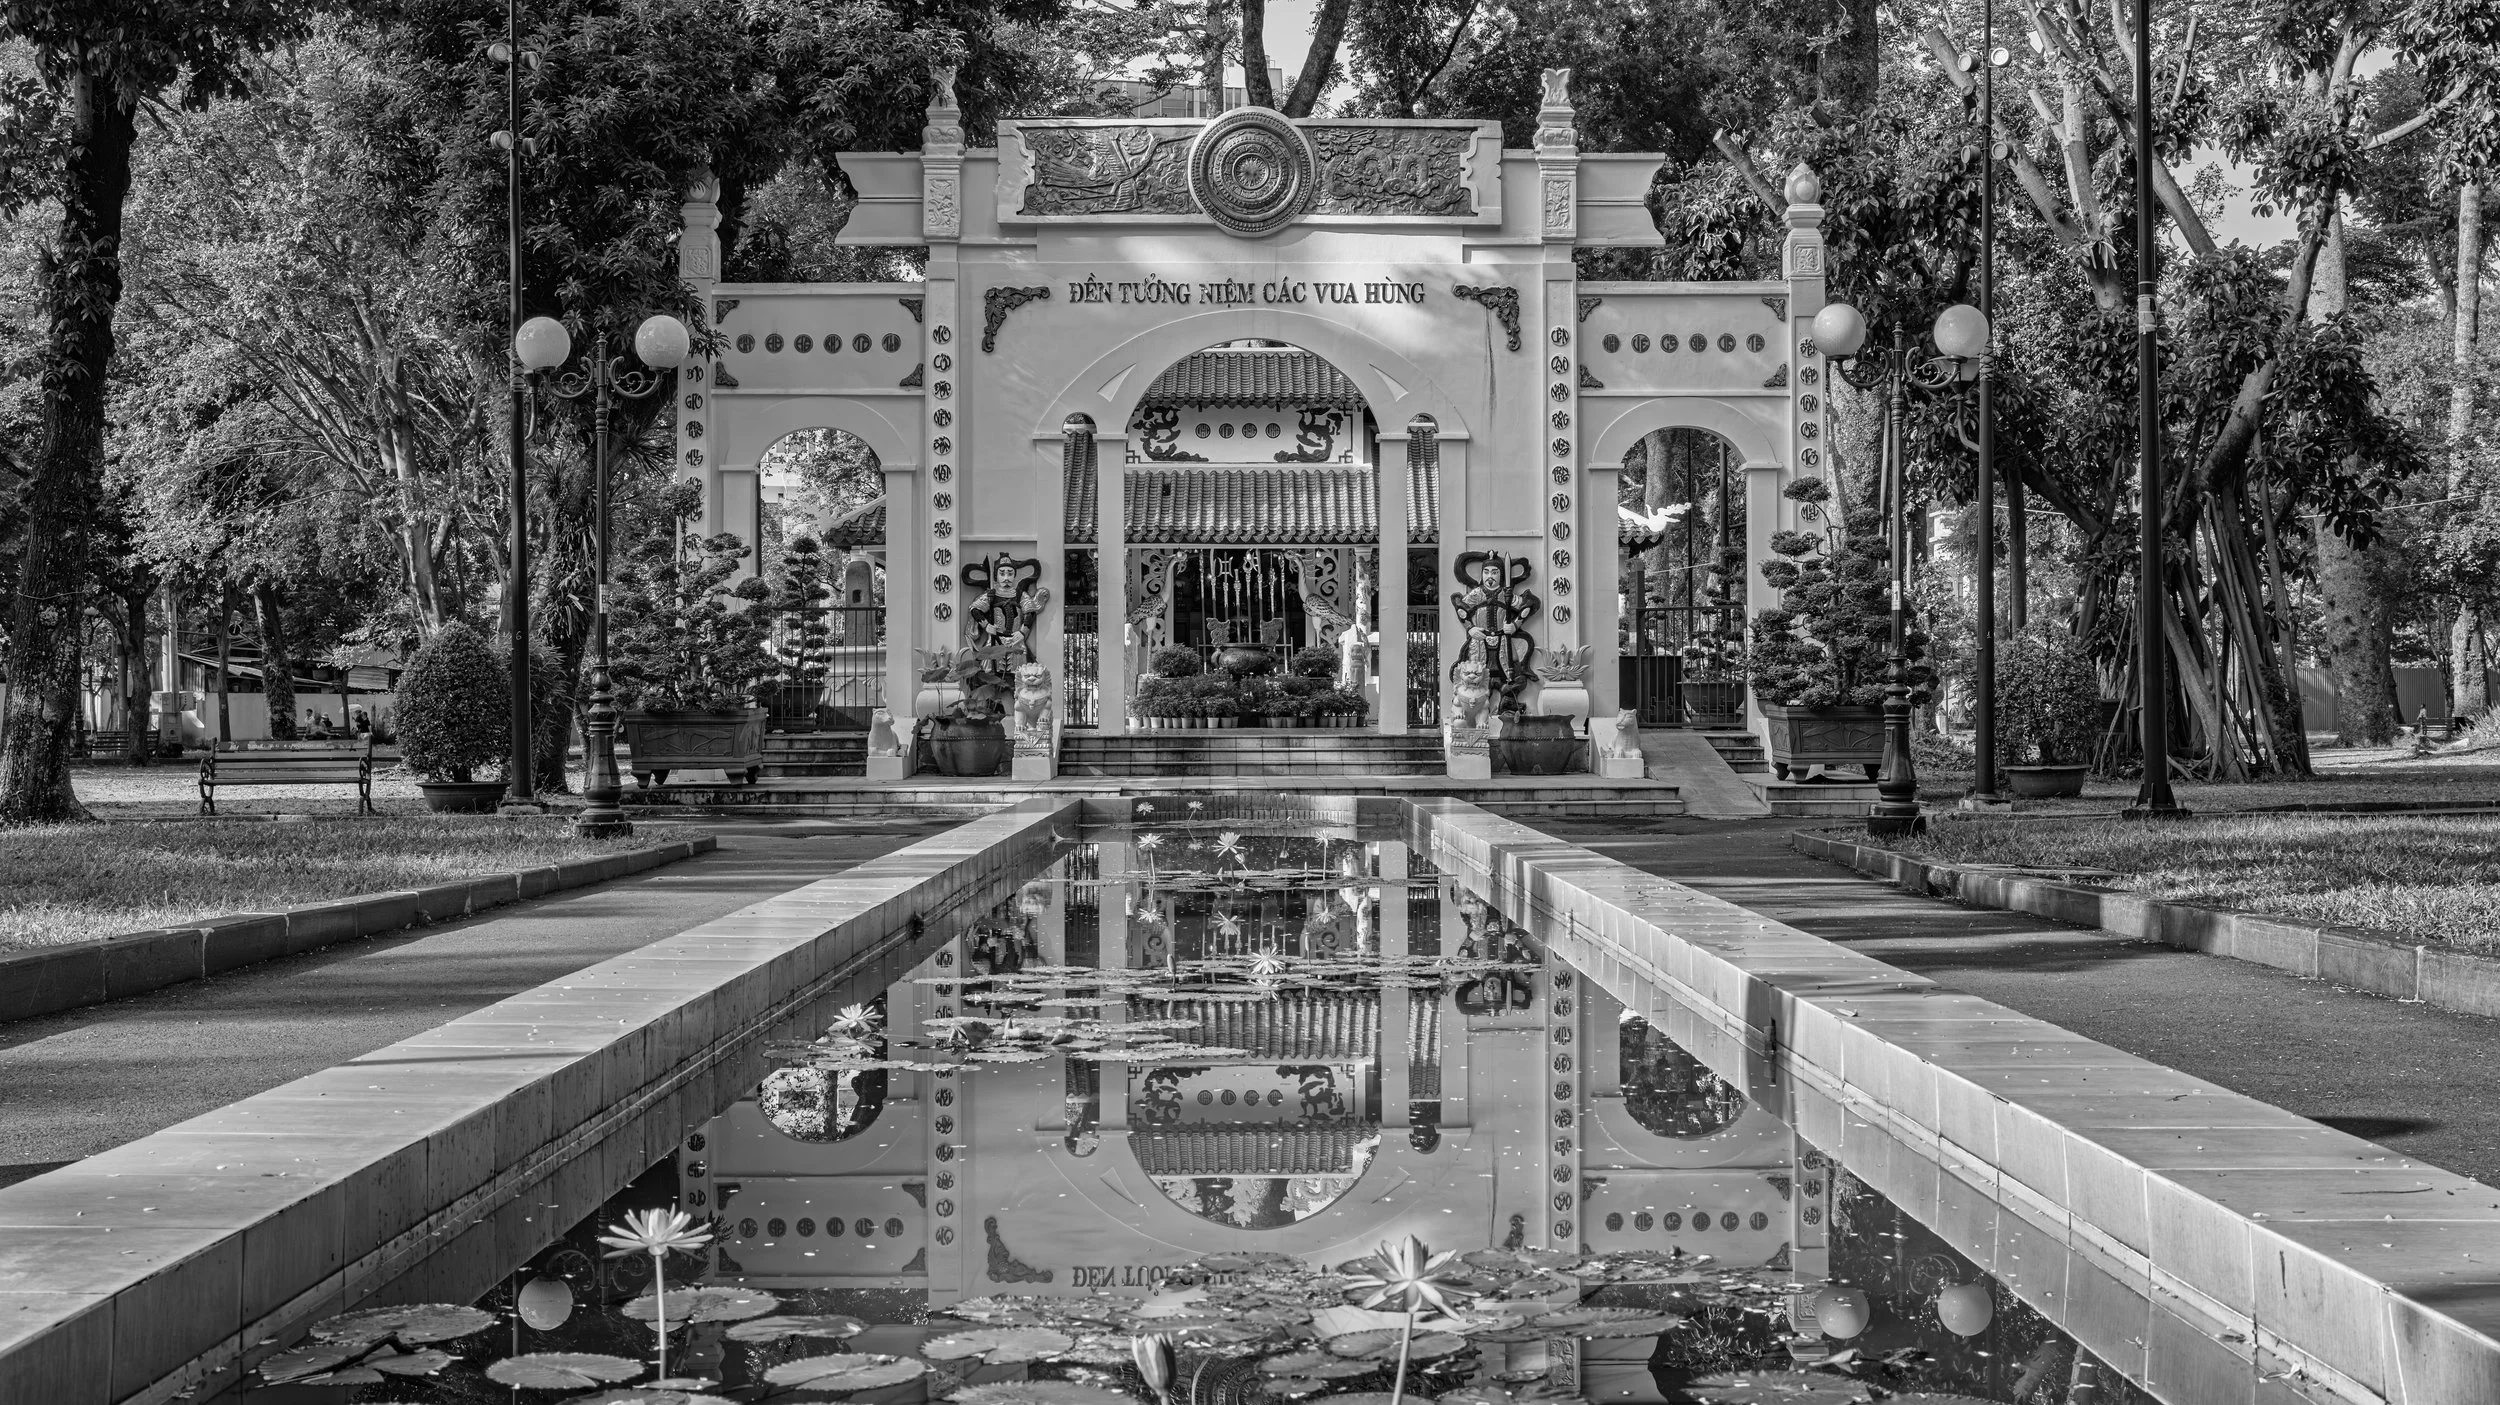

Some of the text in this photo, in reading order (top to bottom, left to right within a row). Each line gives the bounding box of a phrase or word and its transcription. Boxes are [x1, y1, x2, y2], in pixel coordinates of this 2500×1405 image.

[1069, 273, 1425, 308] ĐỀN TƯỞNG NIỆM CÁC VUA HÙNG
